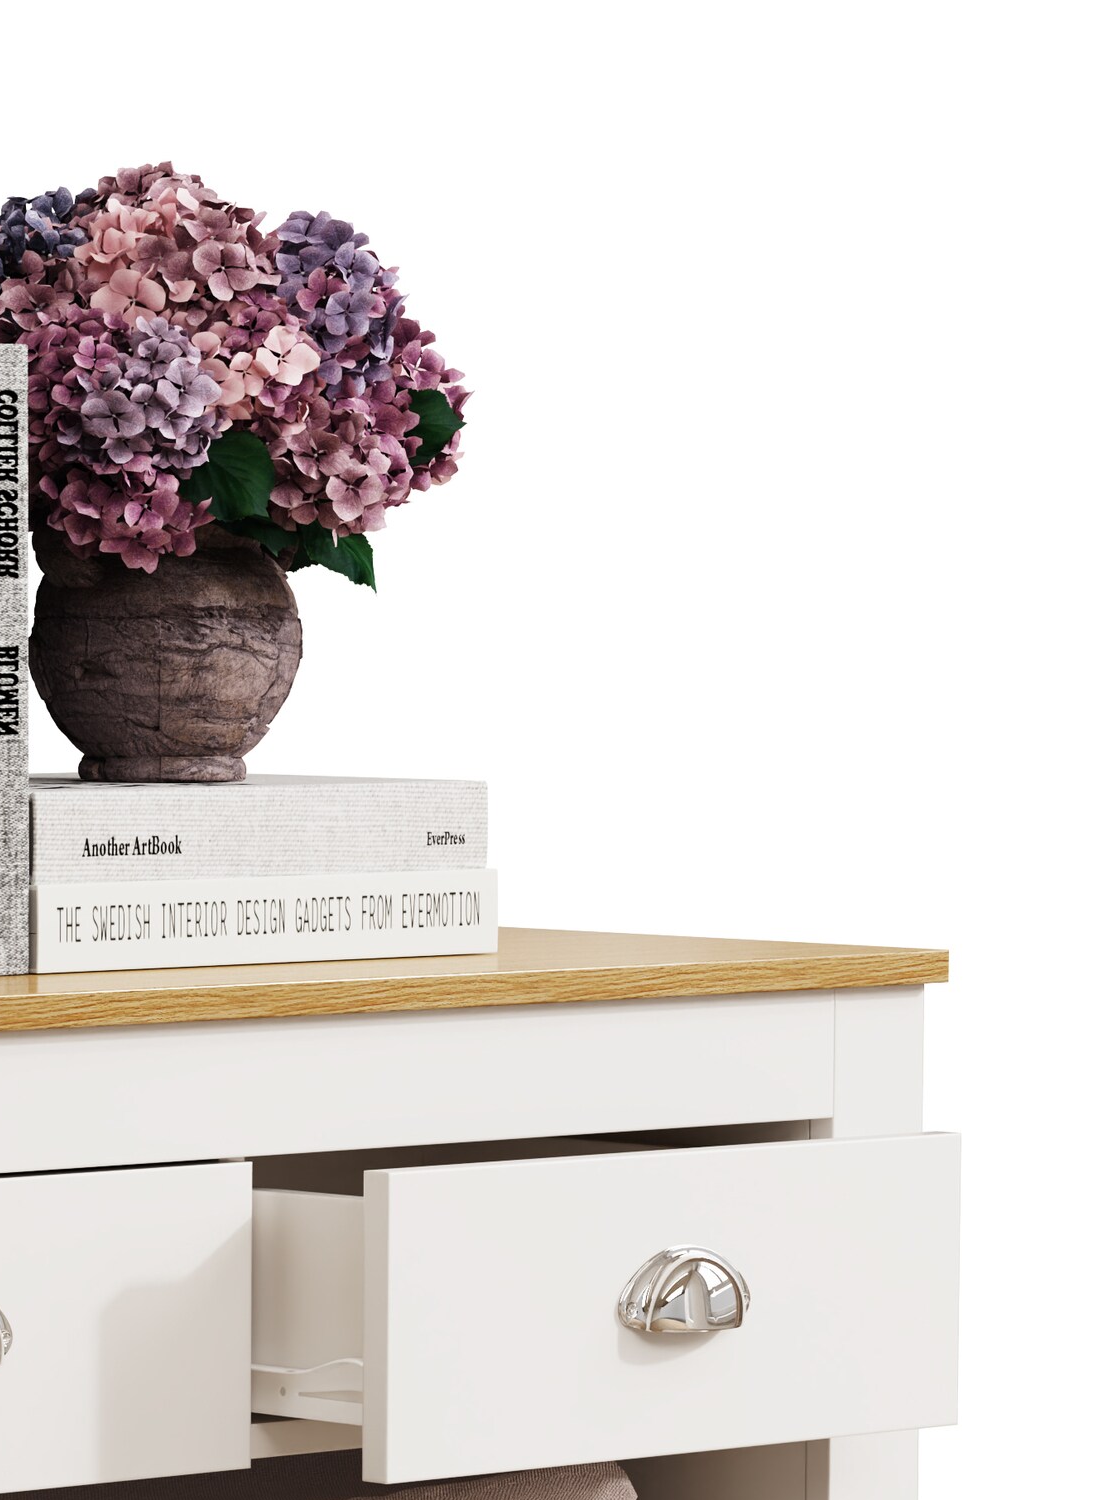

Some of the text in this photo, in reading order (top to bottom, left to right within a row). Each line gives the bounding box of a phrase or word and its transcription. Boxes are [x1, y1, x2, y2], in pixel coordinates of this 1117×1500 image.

[82, 834, 182, 858] Another ArtBook
[426, 831, 466, 846] EverPress
[56, 891, 480, 943] THE SWEDISH INTERIOR DESIGN GADGETS FROM EVERMOTION
